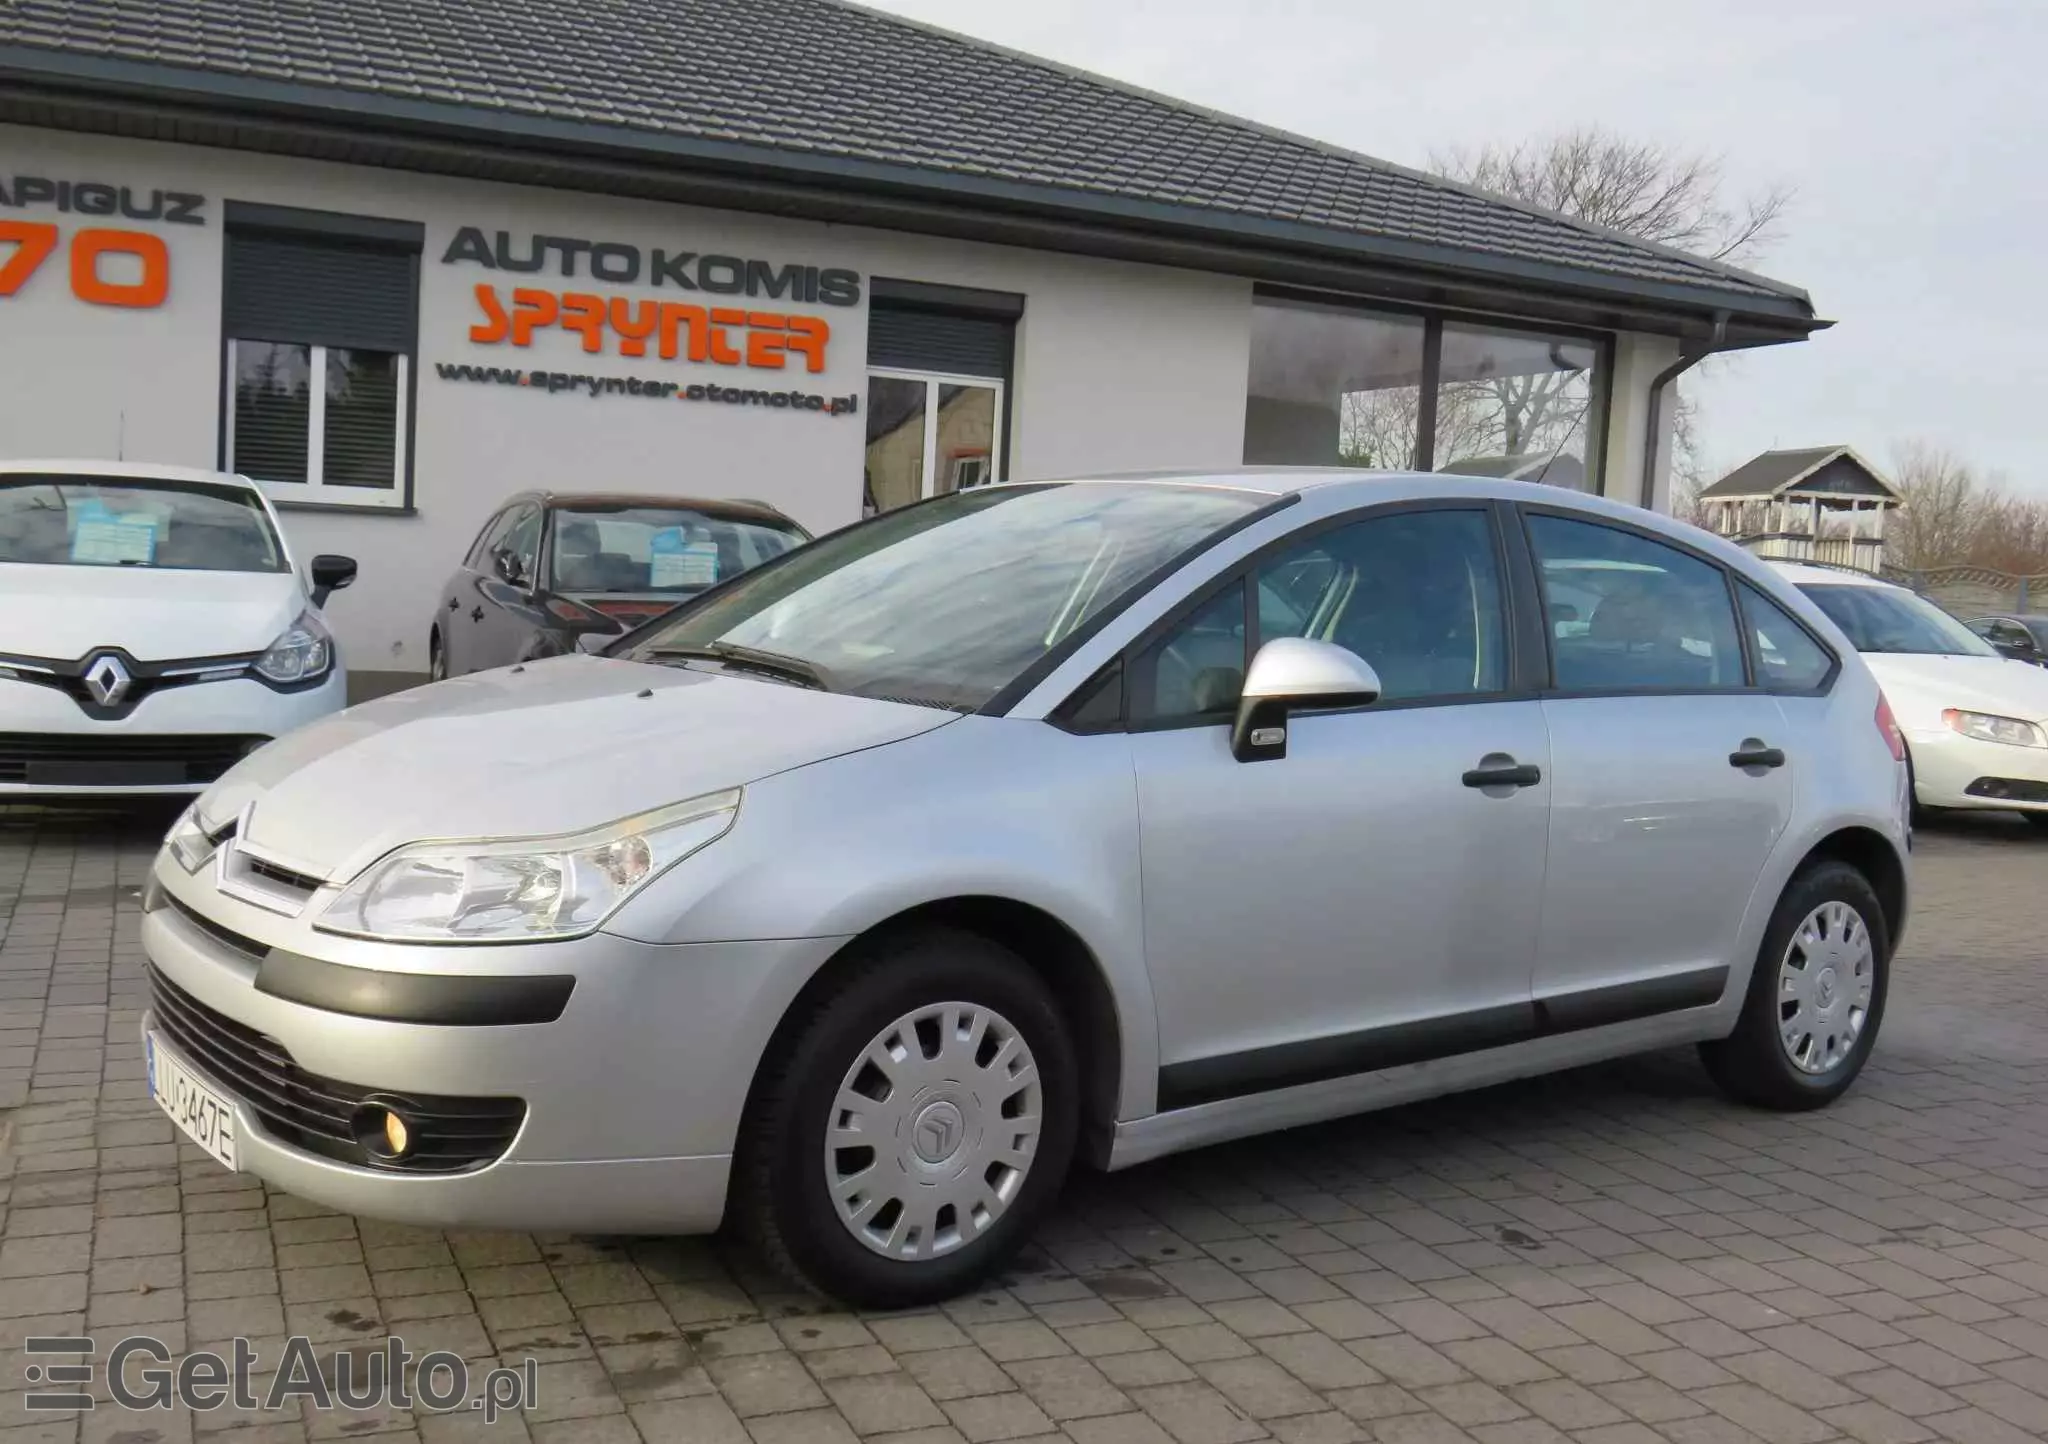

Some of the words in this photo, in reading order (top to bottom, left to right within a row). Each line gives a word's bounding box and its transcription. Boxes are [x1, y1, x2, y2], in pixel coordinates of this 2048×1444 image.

[441, 226, 640, 283] AUTO
[650, 249, 861, 308] KOMIS
[469, 283, 831, 374] SPRYNTER
[435, 363, 858, 416] www.sprynter.otomoto.pl
